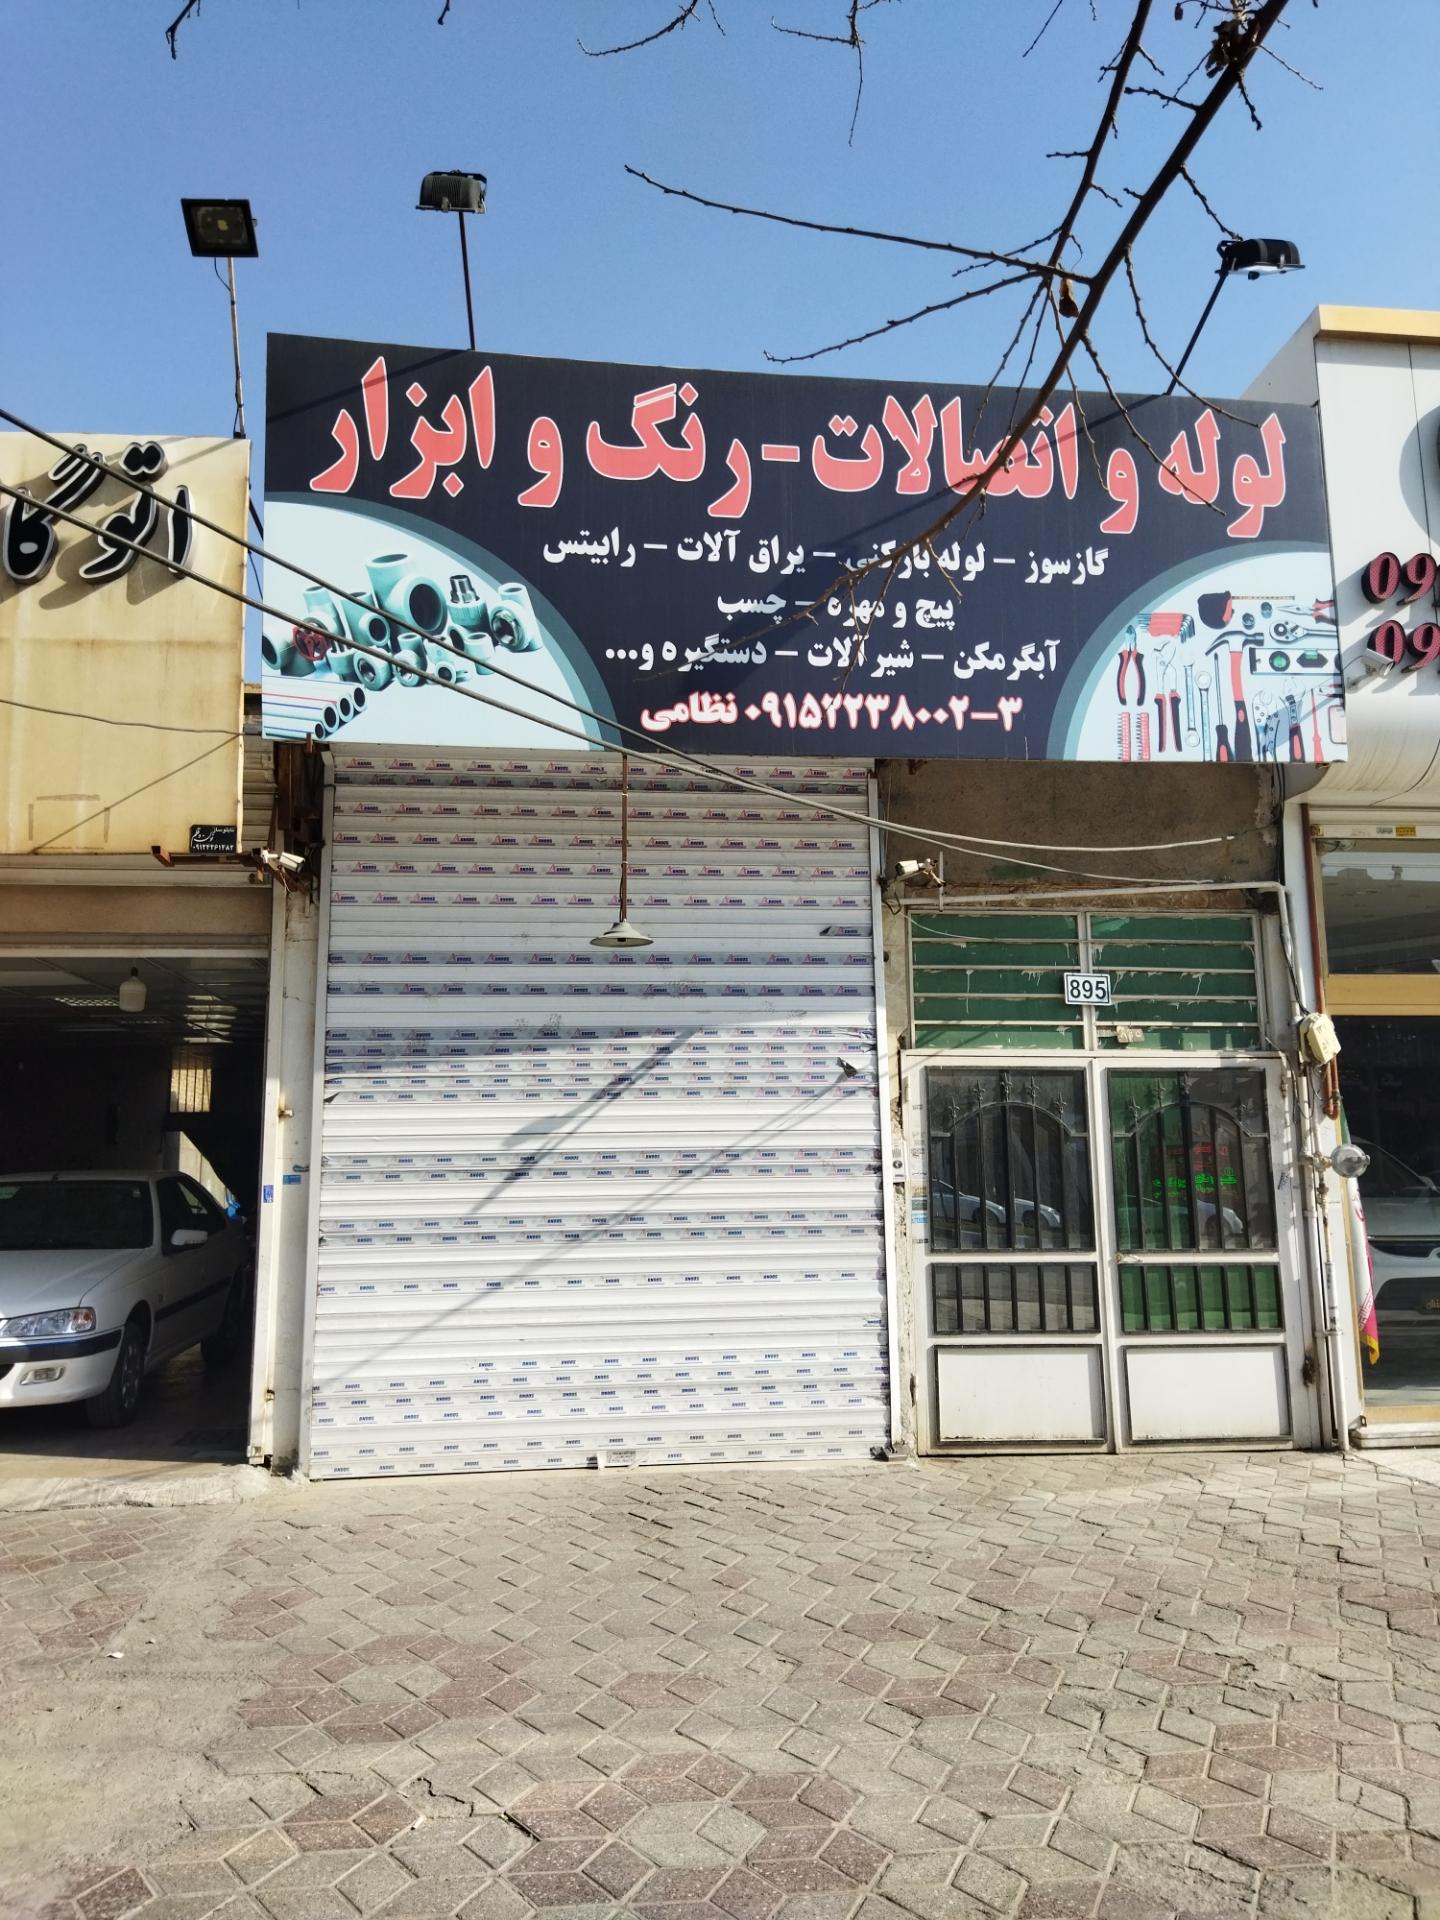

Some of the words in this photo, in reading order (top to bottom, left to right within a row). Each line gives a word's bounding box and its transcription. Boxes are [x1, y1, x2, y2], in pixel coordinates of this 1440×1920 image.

[310, 356, 495, 498] ابزار
[813, 394, 1079, 500] اتصالات
[518, 417, 563, 507] و
[586, 382, 751, 517] رنگ
[1100, 448, 1139, 534] و
[1159, 409, 1286, 537] لوله
[543, 527, 636, 567] رابیتس
[677, 529, 741, 562] آلات
[749, 535, 806, 575] یراق
[937, 541, 985, 581] لوله
[1361, 552, 1440, 606] 09
[717, 594, 786, 624] چسب
[827, 597, 885, 627] مهره
[893, 601, 907, 628] و
[915, 598, 955, 630] پیچ
[640, 691, 738, 732] نظامی
[1070, 980, 1106, 999] 895
